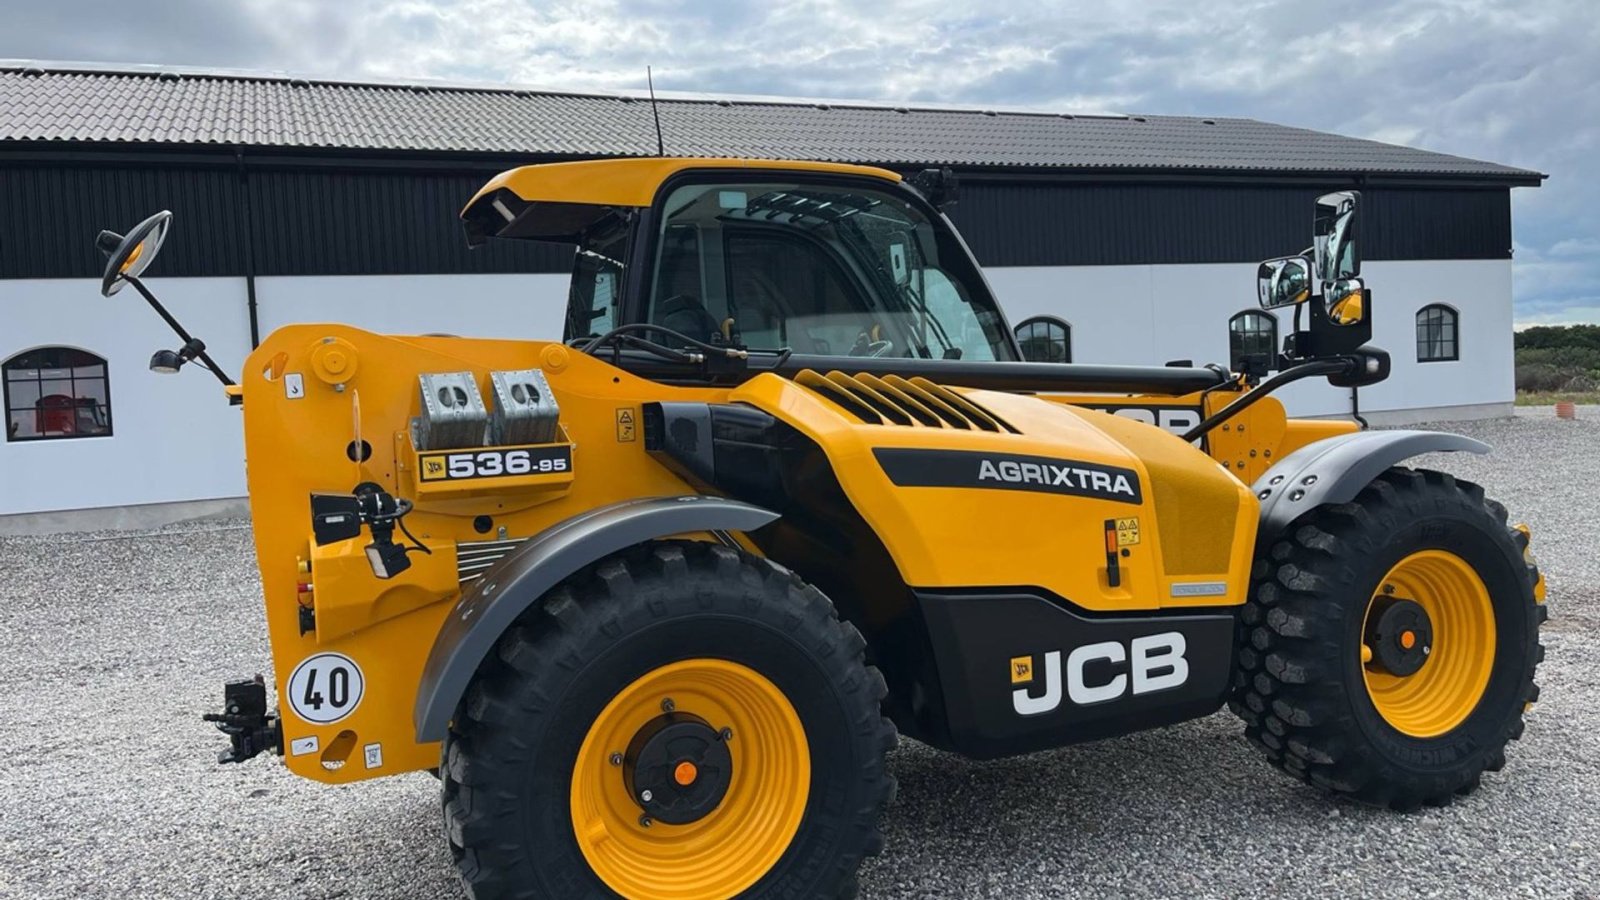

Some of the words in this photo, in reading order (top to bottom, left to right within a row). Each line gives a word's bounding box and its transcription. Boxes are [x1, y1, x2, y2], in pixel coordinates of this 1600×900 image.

[448, 450, 567, 478] 536-95
[978, 459, 1135, 496] AGRIXTRA
[303, 666, 349, 710] 40
[1012, 631, 1189, 715] JCB
